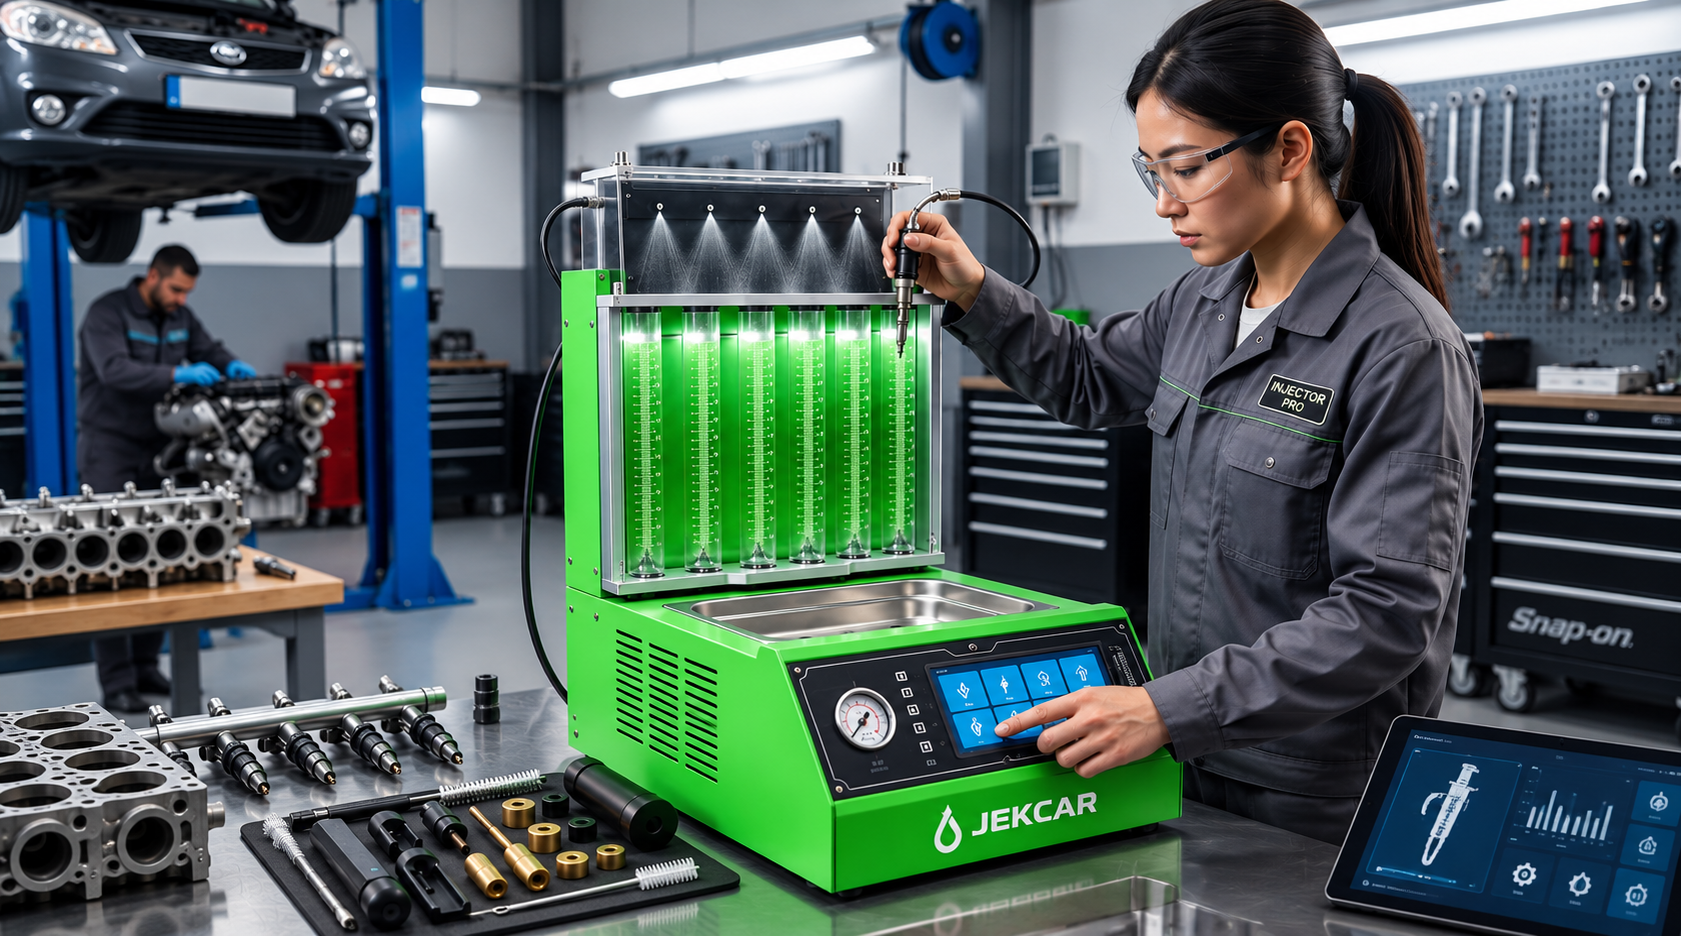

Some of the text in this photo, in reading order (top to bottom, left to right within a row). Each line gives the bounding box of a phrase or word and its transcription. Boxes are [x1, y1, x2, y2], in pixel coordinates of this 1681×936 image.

[1271, 381, 1326, 405] INJECTOR
[1281, 398, 1304, 412] PRO
[972, 792, 1097, 836] JEKCAR
